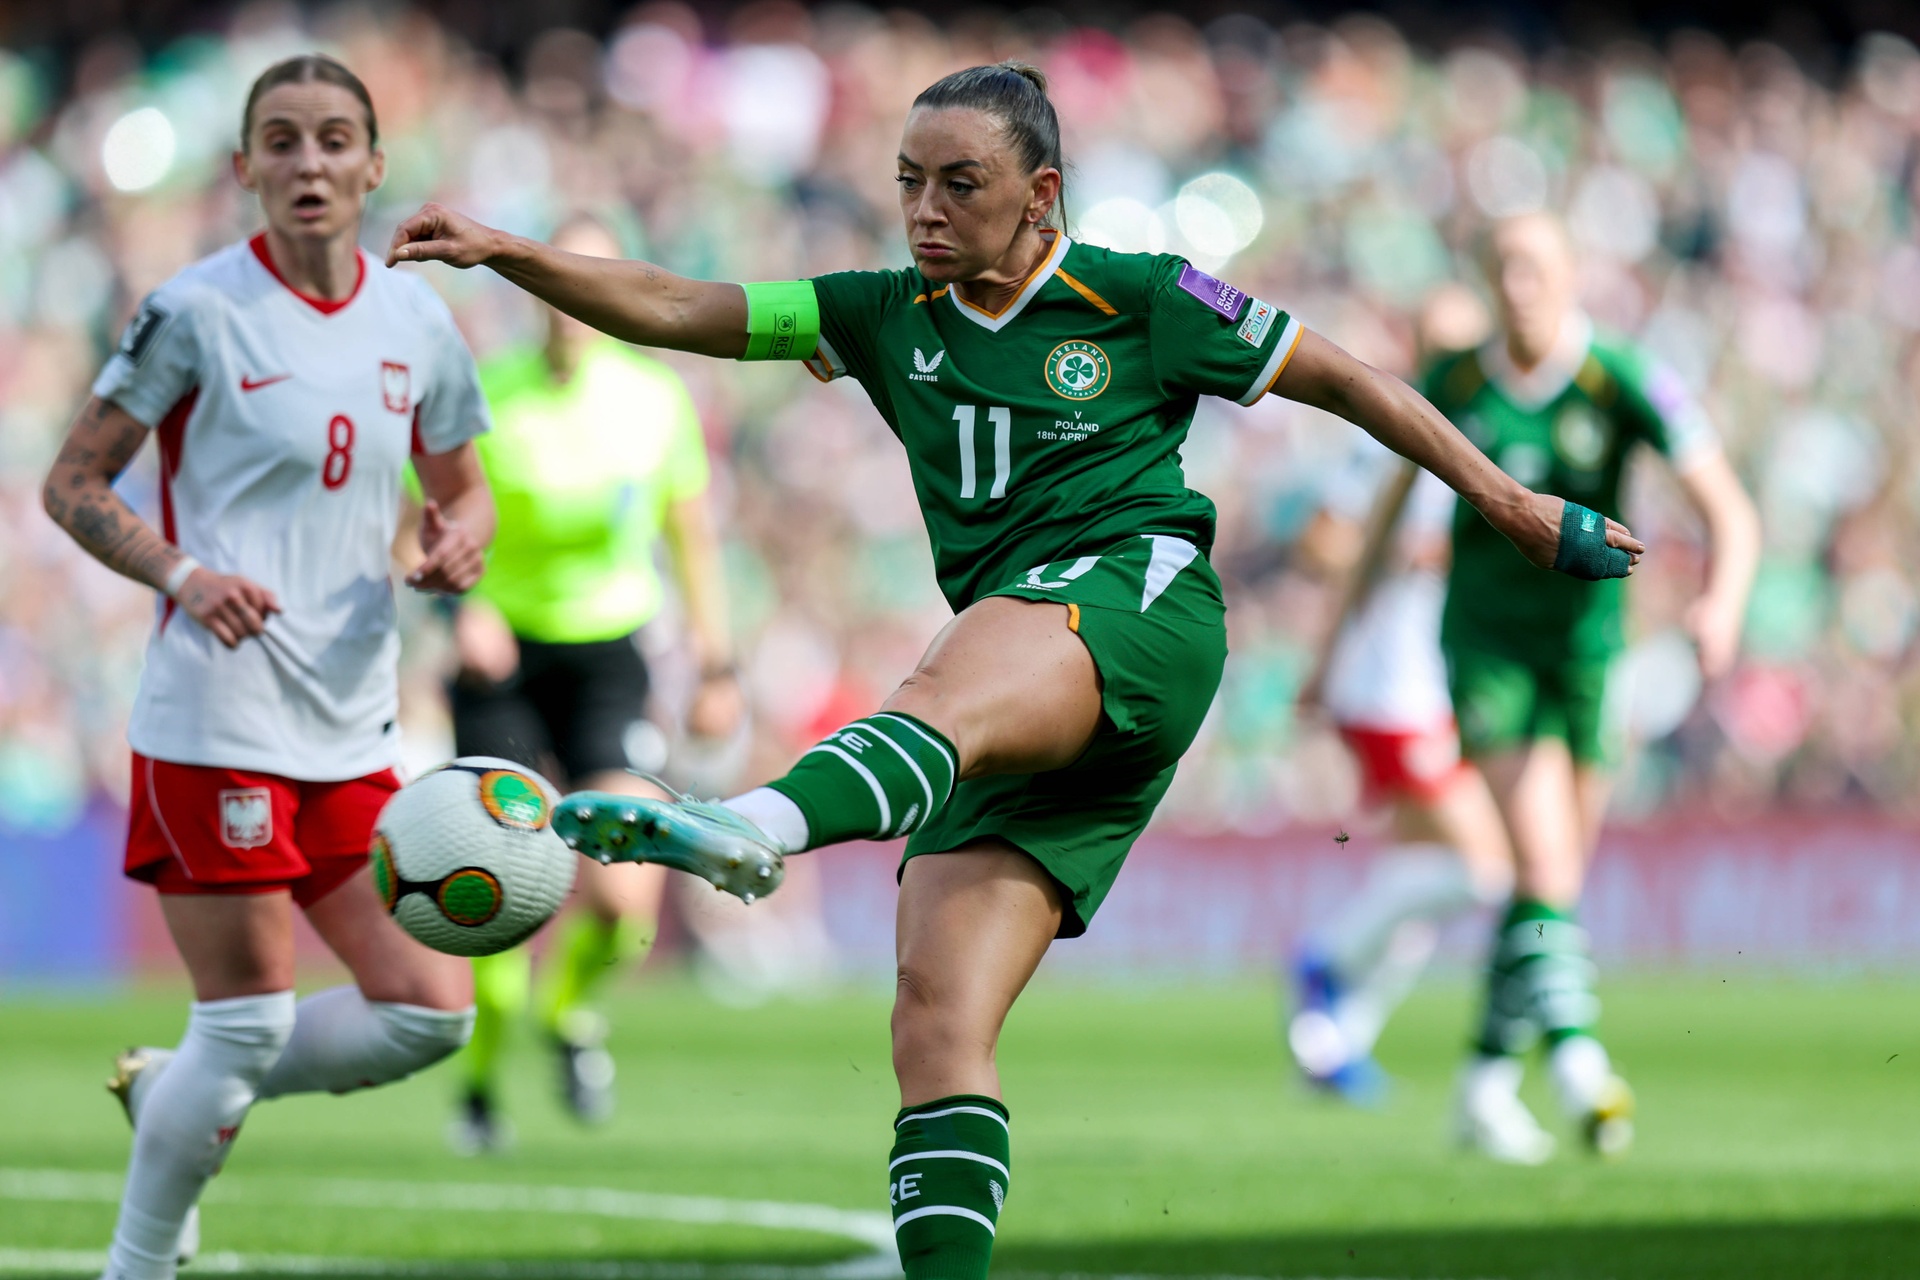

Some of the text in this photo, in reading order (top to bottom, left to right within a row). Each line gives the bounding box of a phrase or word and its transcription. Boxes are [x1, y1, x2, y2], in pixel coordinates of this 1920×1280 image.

[1216, 283, 1232, 307] EURO
[1051, 343, 1104, 363] IRELAND
[908, 373, 938, 382] CASTORE
[1058, 386, 1098, 397] FOOTBALL
[1074, 410, 1082, 420] V
[1055, 420, 1100, 433] POLAND
[1036, 430, 1057, 440] 18th
[323, 414, 354, 492] 8
[952, 405, 1011, 499] 11
